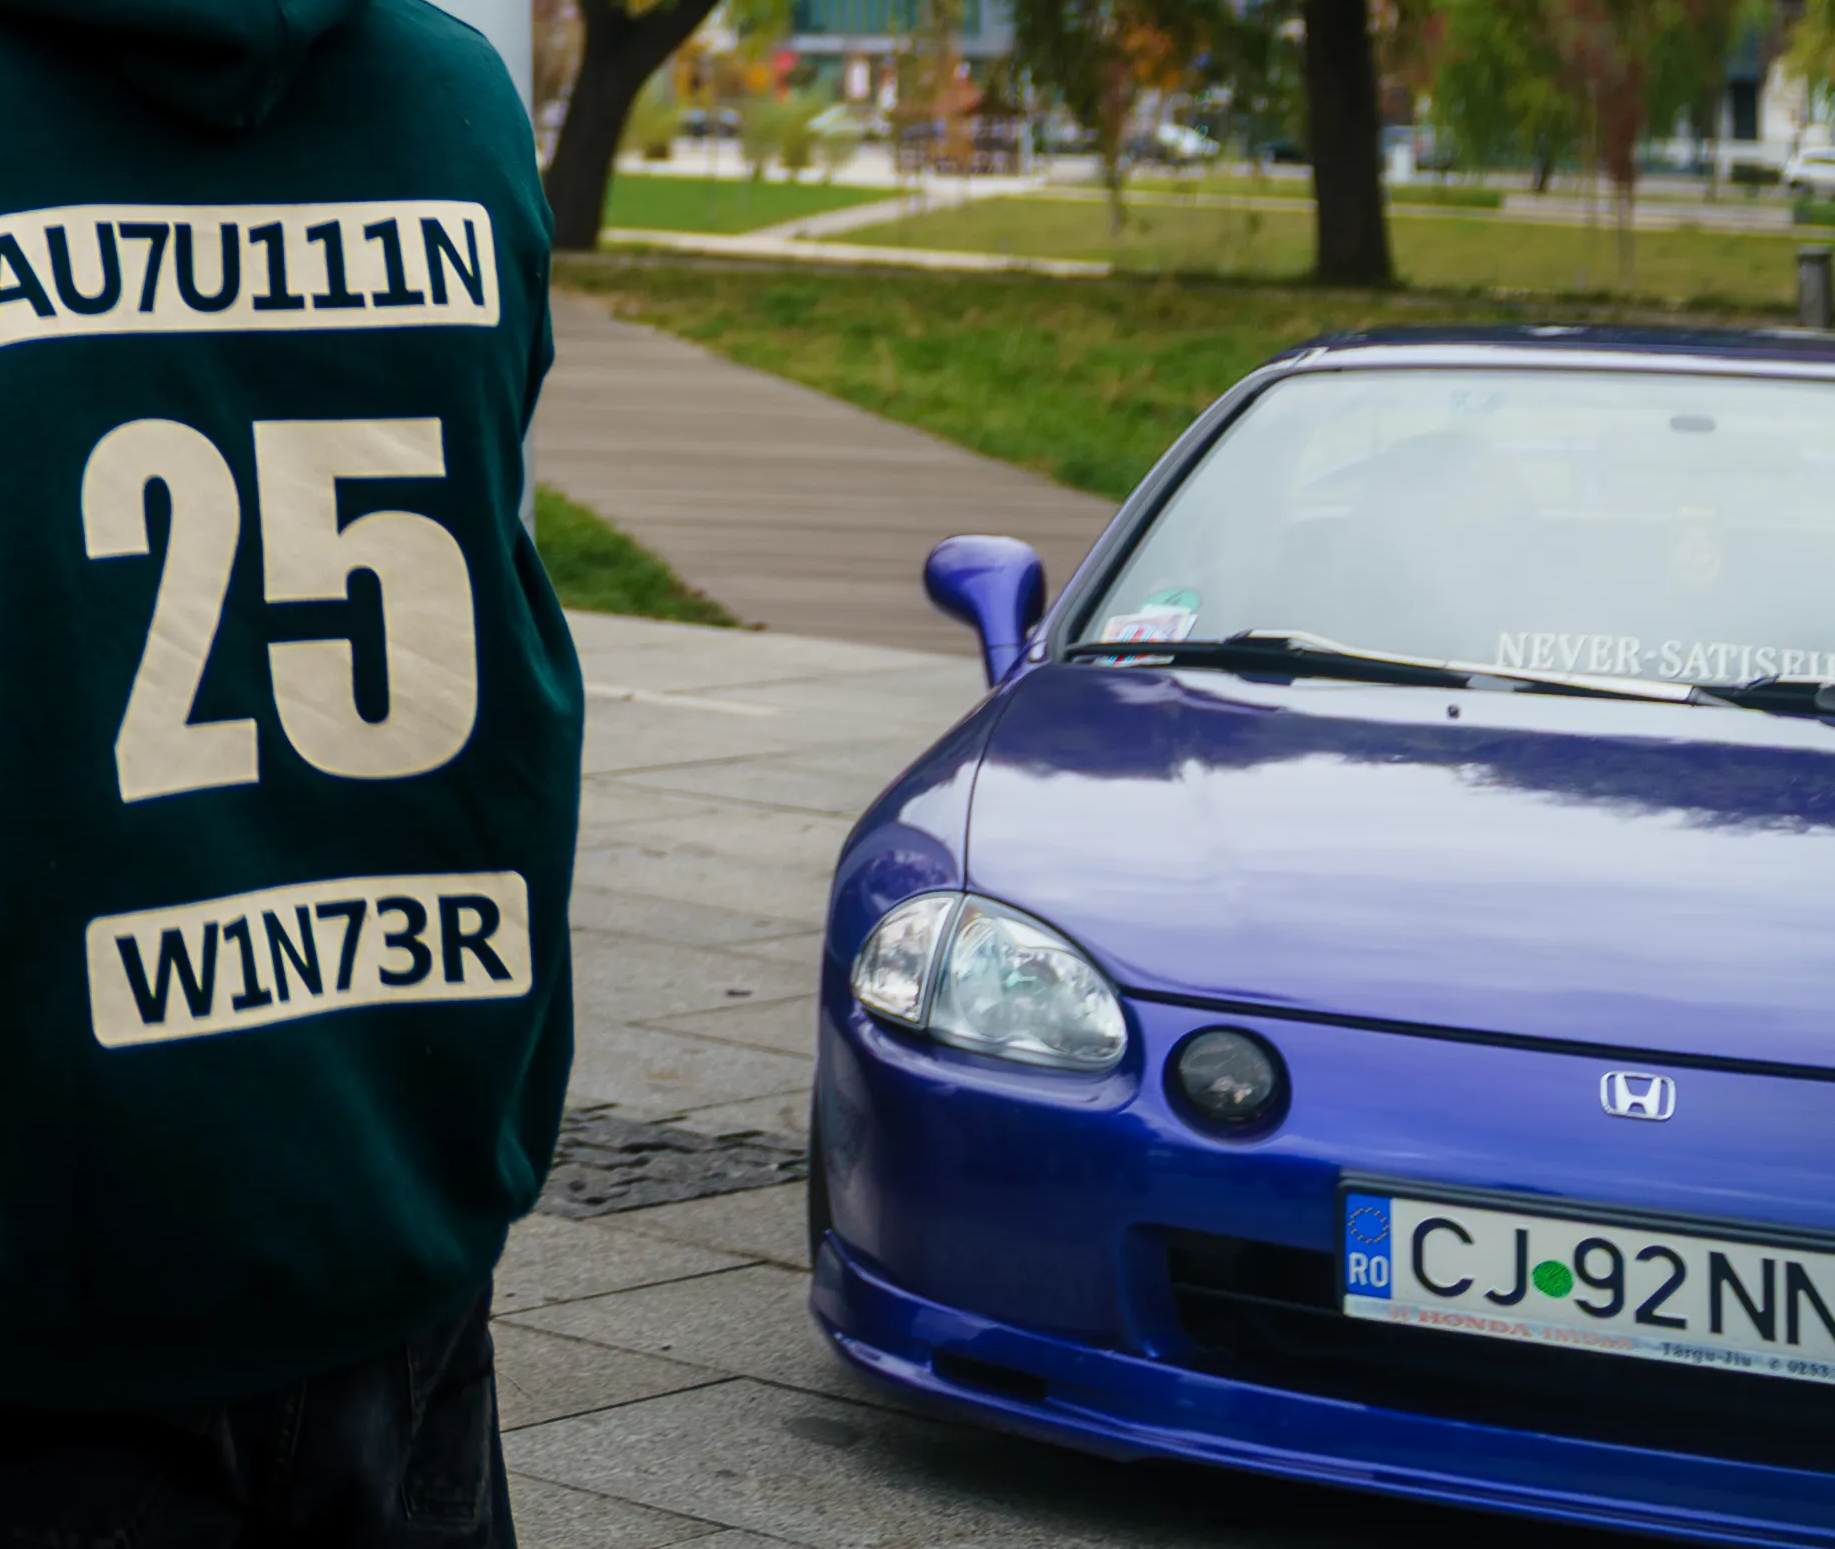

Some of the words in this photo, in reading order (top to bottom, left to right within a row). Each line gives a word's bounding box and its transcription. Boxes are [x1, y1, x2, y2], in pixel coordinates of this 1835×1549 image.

[80, 416, 480, 804] 25
[114, 894, 513, 1026] W1N73R
[1349, 1252, 1389, 1289] RO
[1412, 1217, 1529, 1306] CJ
[1418, 1308, 1534, 1340] HONDA
